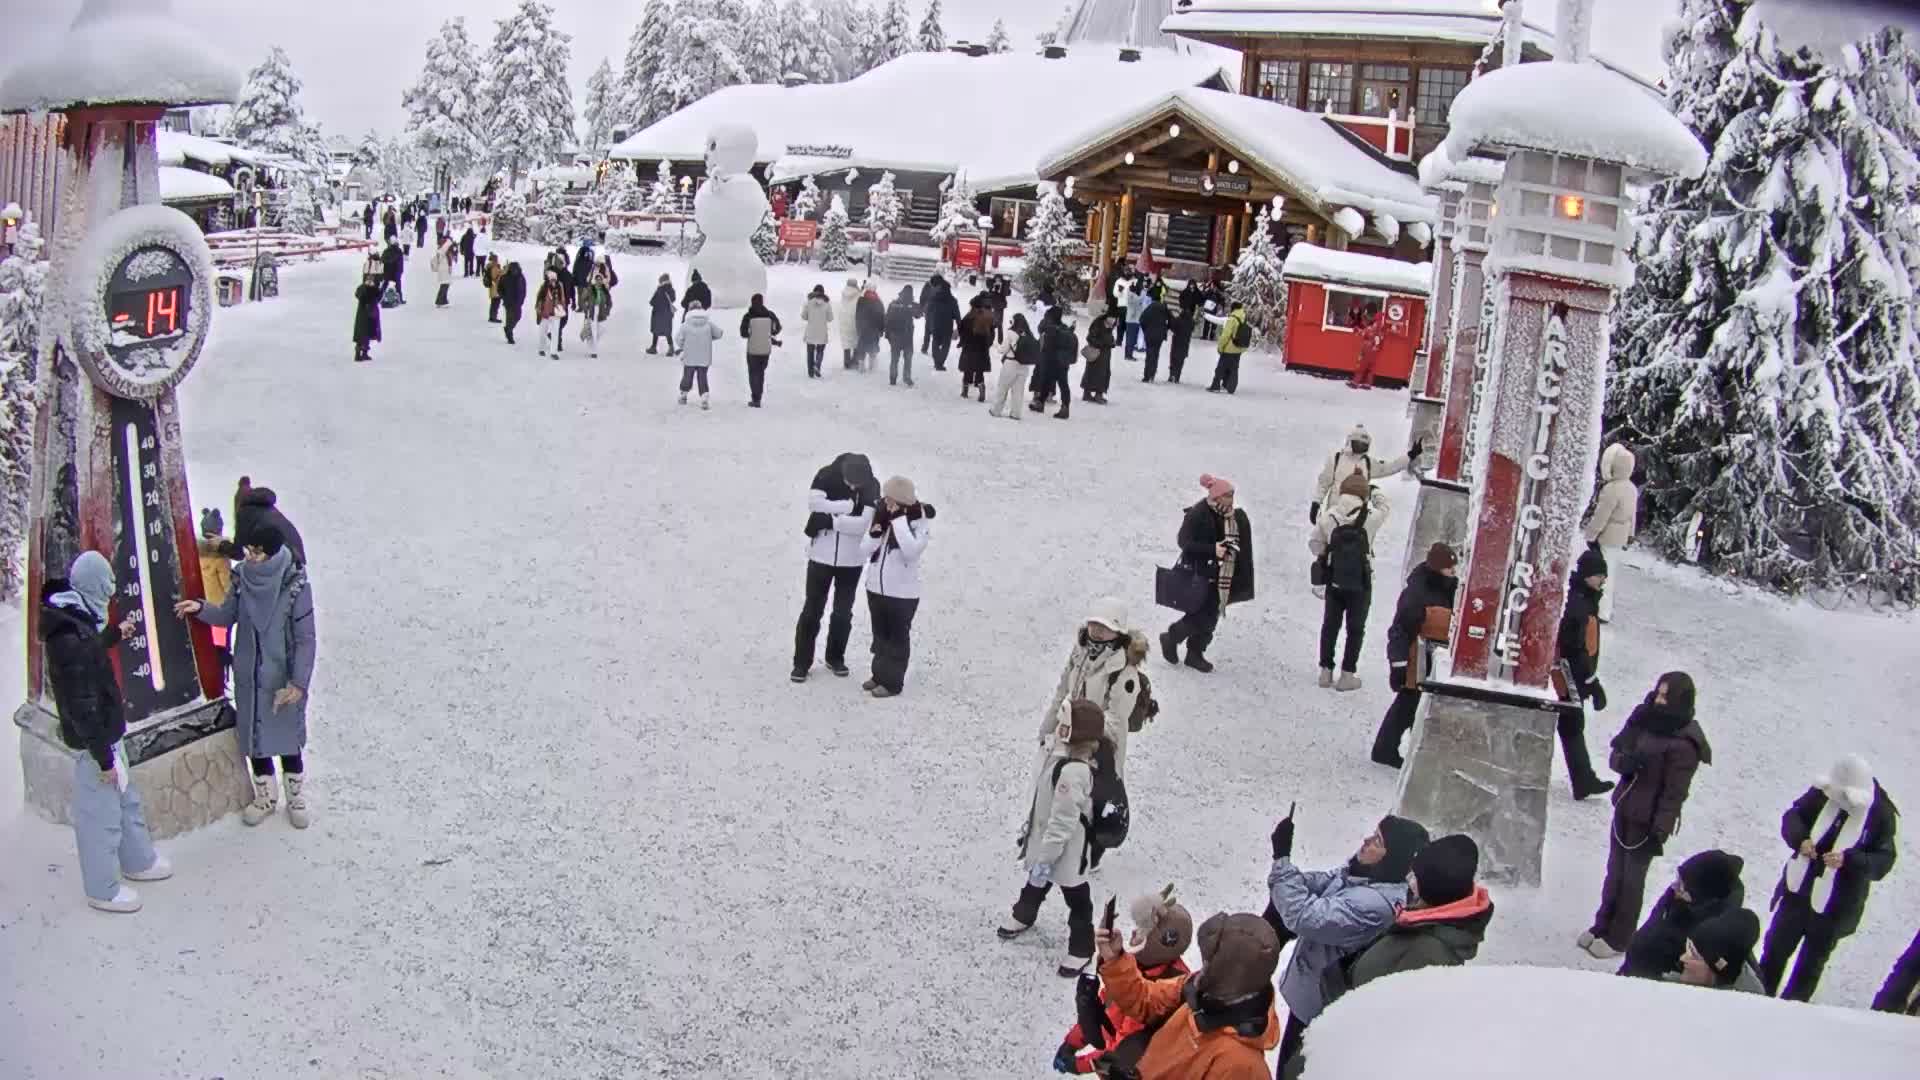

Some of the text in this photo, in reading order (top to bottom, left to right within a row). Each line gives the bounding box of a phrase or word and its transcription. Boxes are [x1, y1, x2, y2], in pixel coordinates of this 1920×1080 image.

[141, 435, 155, 449] 40
[143, 462, 157, 479] 30
[145, 490, 159, 507] 20
[1499, 315, 1568, 666] ARCTIC CIRCLE
[148, 519, 161, 537] 10
[129, 555, 137, 569] 0
[151, 549, 159, 563] 0
[124, 582, 140, 597] -10
[128, 634, 146, 651] -30
[132, 662, 150, 678] -40
